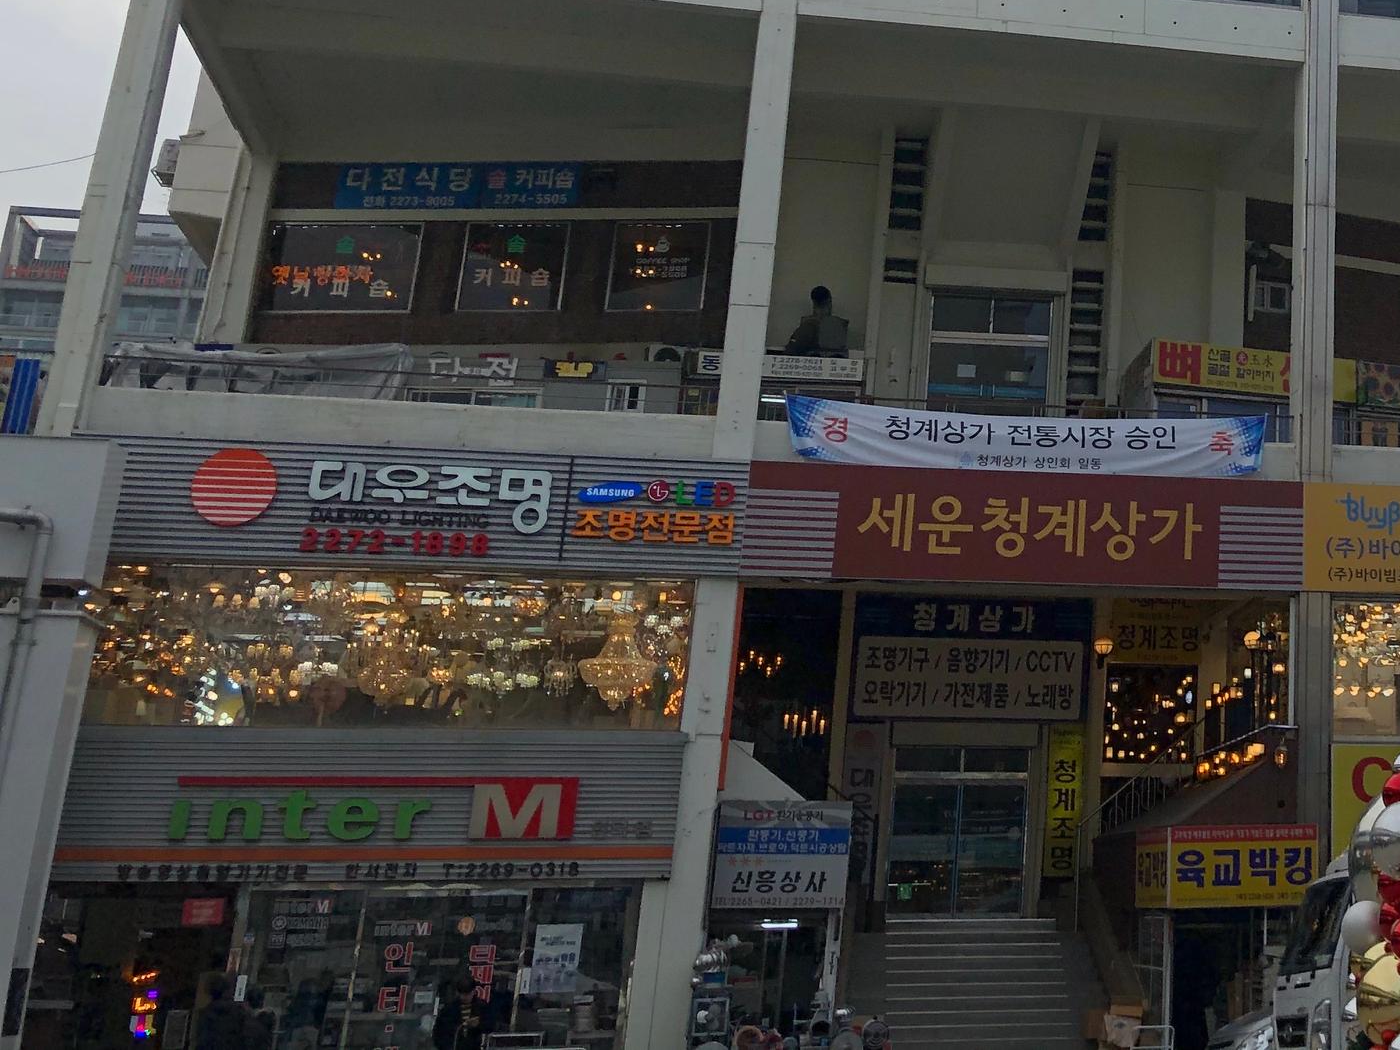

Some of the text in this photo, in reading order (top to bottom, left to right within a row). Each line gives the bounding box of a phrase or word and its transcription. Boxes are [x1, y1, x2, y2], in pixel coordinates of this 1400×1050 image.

[345, 166, 474, 192] 다전식당
[515, 169, 575, 190] 커피숍
[473, 267, 551, 288] 커피숍
[1159, 341, 1202, 385] 뼈
[823, 415, 1235, 455] 경 청계상가 전통시장 승인 축
[977, 453, 1102, 470] 청계상가 상인회 일동
[308, 460, 552, 534] 대우조명
[586, 487, 635, 498] SAMSUNG
[675, 480, 737, 507] LED
[308, 506, 489, 528] DAEWOO LIGHTING
[571, 508, 736, 545] 조명전문점
[857, 493, 1203, 561] 세운청계상가
[300, 527, 490, 556] 2272-1898
[912, 602, 1036, 633] 청계상가
[1117, 624, 1199, 651] 청계조명
[865, 646, 930, 672] 조명기구
[946, 648, 1010, 674] 음향기기
[1026, 650, 1076, 673] CCTV
[863, 680, 927, 707] 오락기기
[944, 682, 1009, 708] 가전제품
[1024, 684, 1075, 710] 노래방
[168, 789, 432, 842] inter
[1051, 759, 1077, 871] 청계조명
[731, 870, 827, 894] 신흥상사
[1176, 847, 1313, 888] 육교박킹
